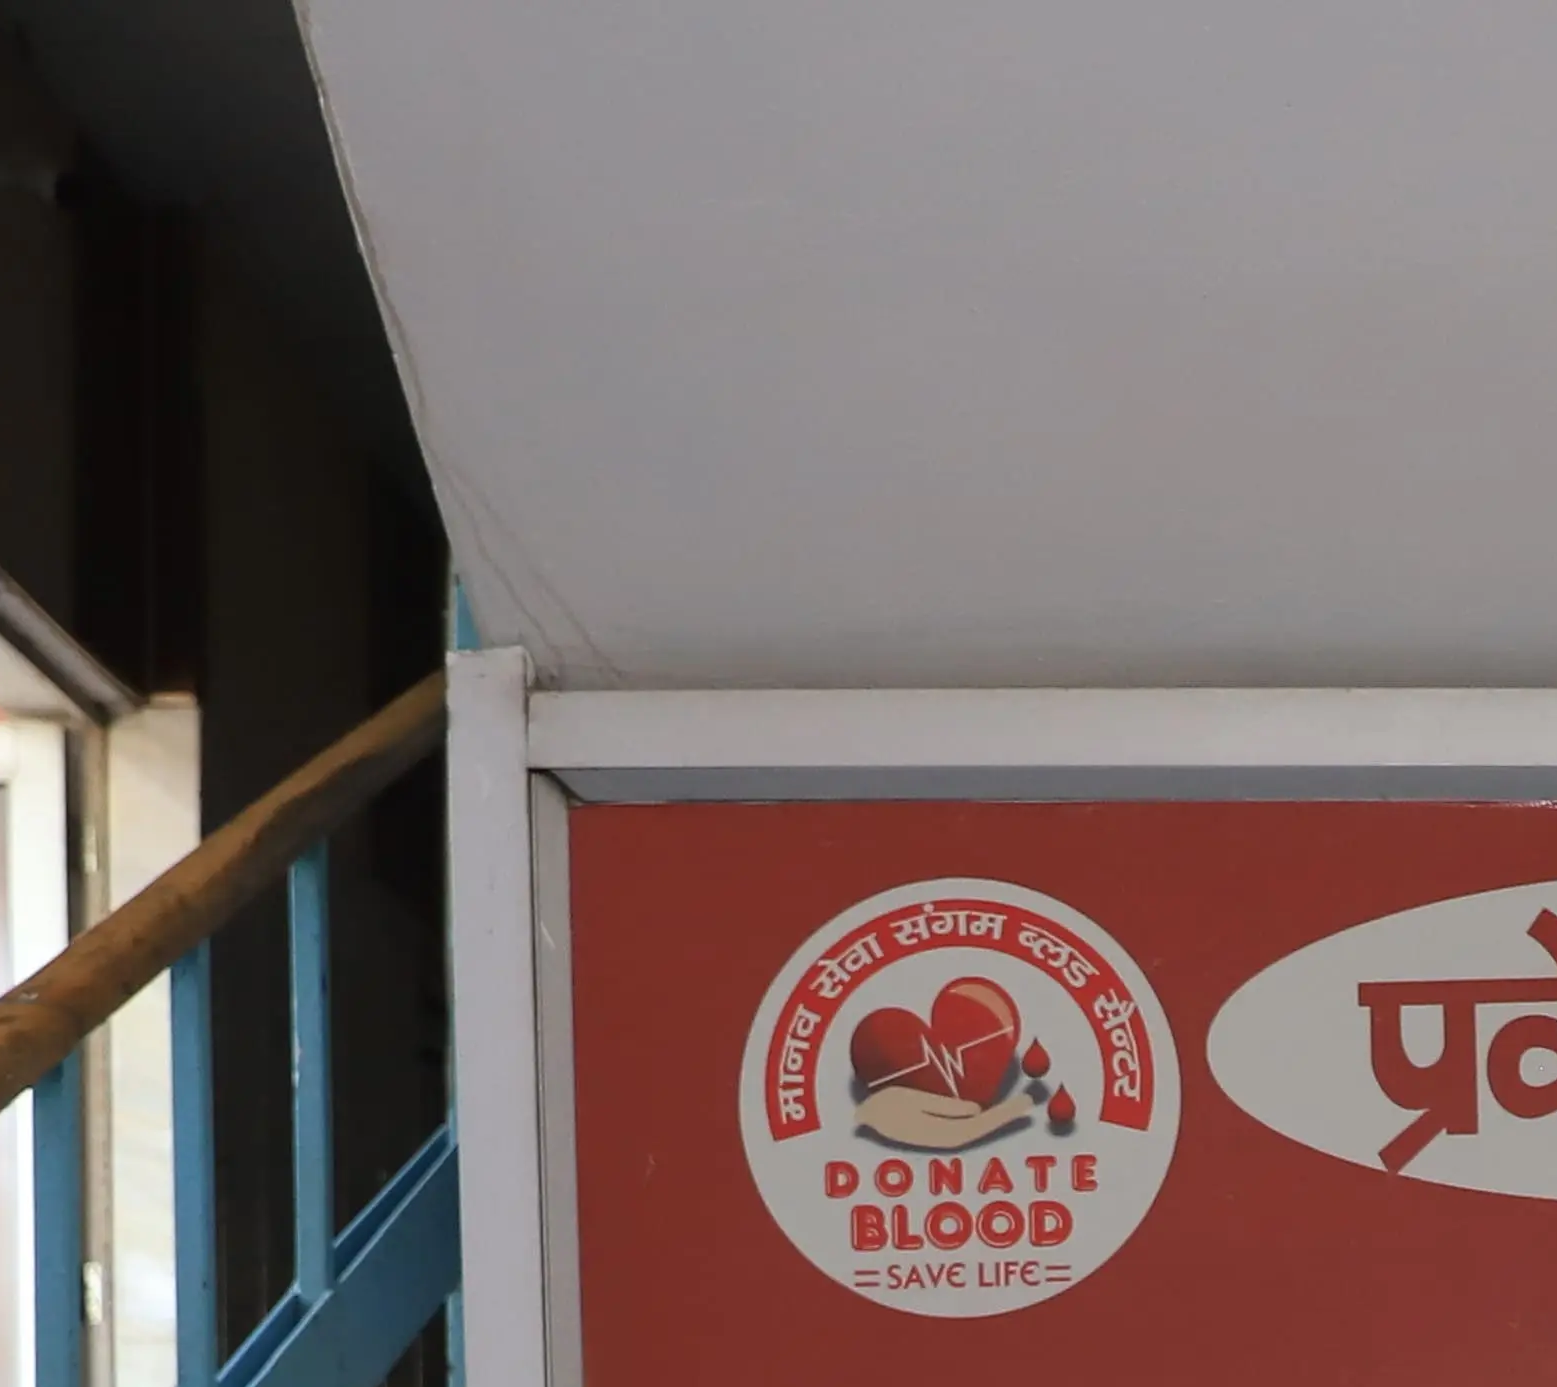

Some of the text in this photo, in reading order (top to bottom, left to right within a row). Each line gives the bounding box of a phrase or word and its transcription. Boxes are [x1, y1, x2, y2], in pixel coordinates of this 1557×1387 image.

[779, 1003, 822, 1124] मानव
[810, 931, 886, 1000] सेवा
[890, 903, 1008, 947] संगम
[824, 1154, 1100, 1199] DONATE
[849, 1201, 1074, 1252] BLOOD
[887, 1260, 1041, 1291] SAVE LIFE
